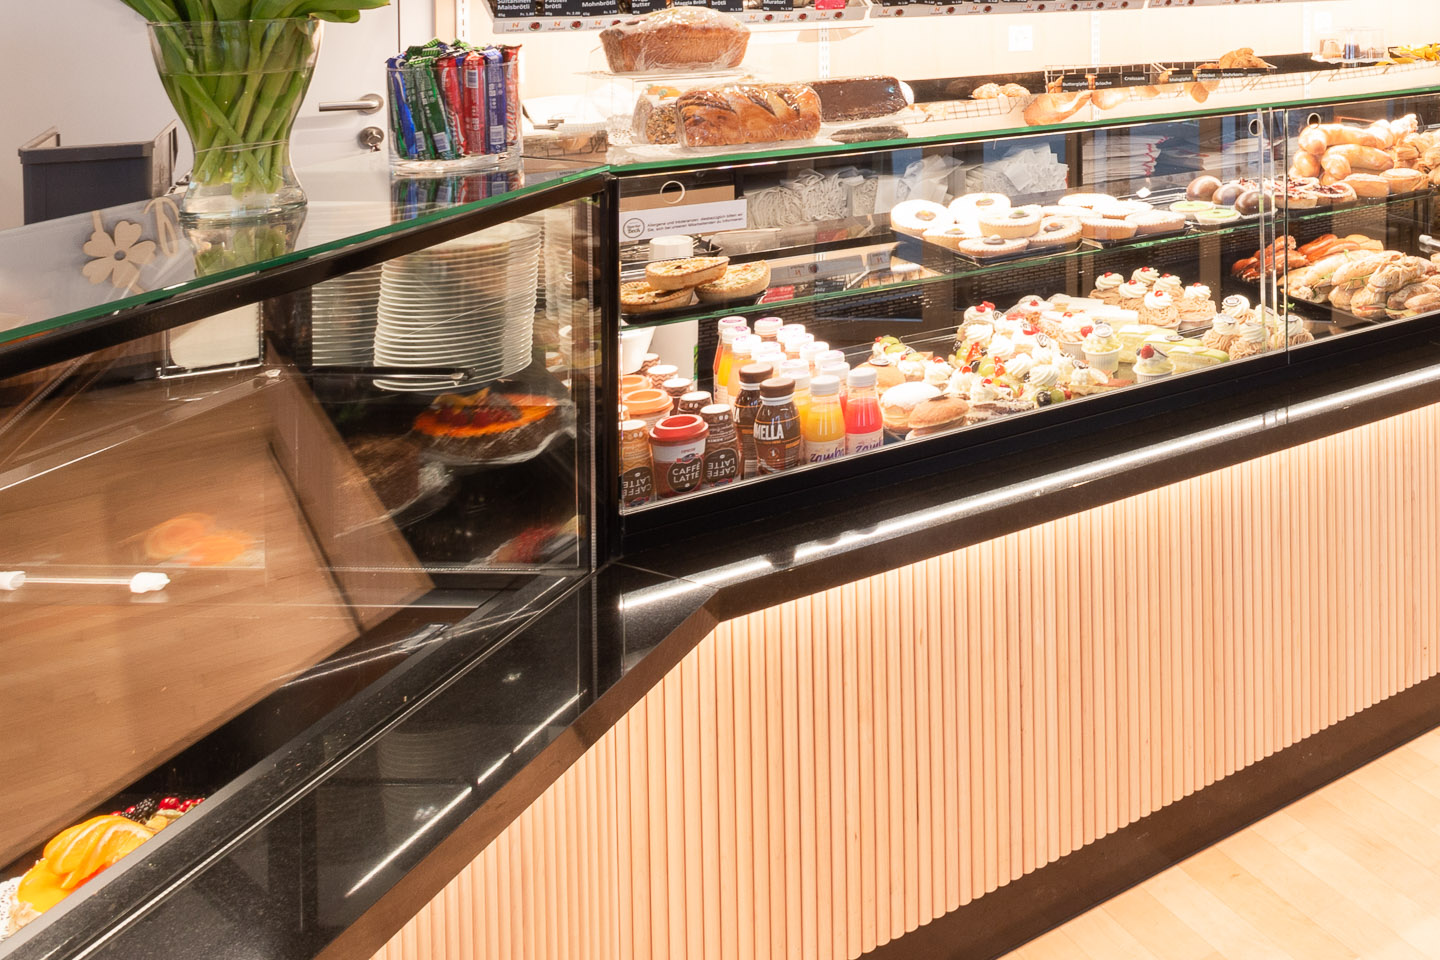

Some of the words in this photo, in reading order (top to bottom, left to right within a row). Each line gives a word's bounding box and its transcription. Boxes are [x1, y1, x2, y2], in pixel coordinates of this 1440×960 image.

[581, 0, 617, 8] Mohnbrötli
[753, 422, 785, 441] MELLA
[672, 461, 700, 476] CAFFÈ
[708, 457, 735, 470] LATTE
[623, 475, 651, 488] LATTE
[673, 470, 700, 483] LATTE
